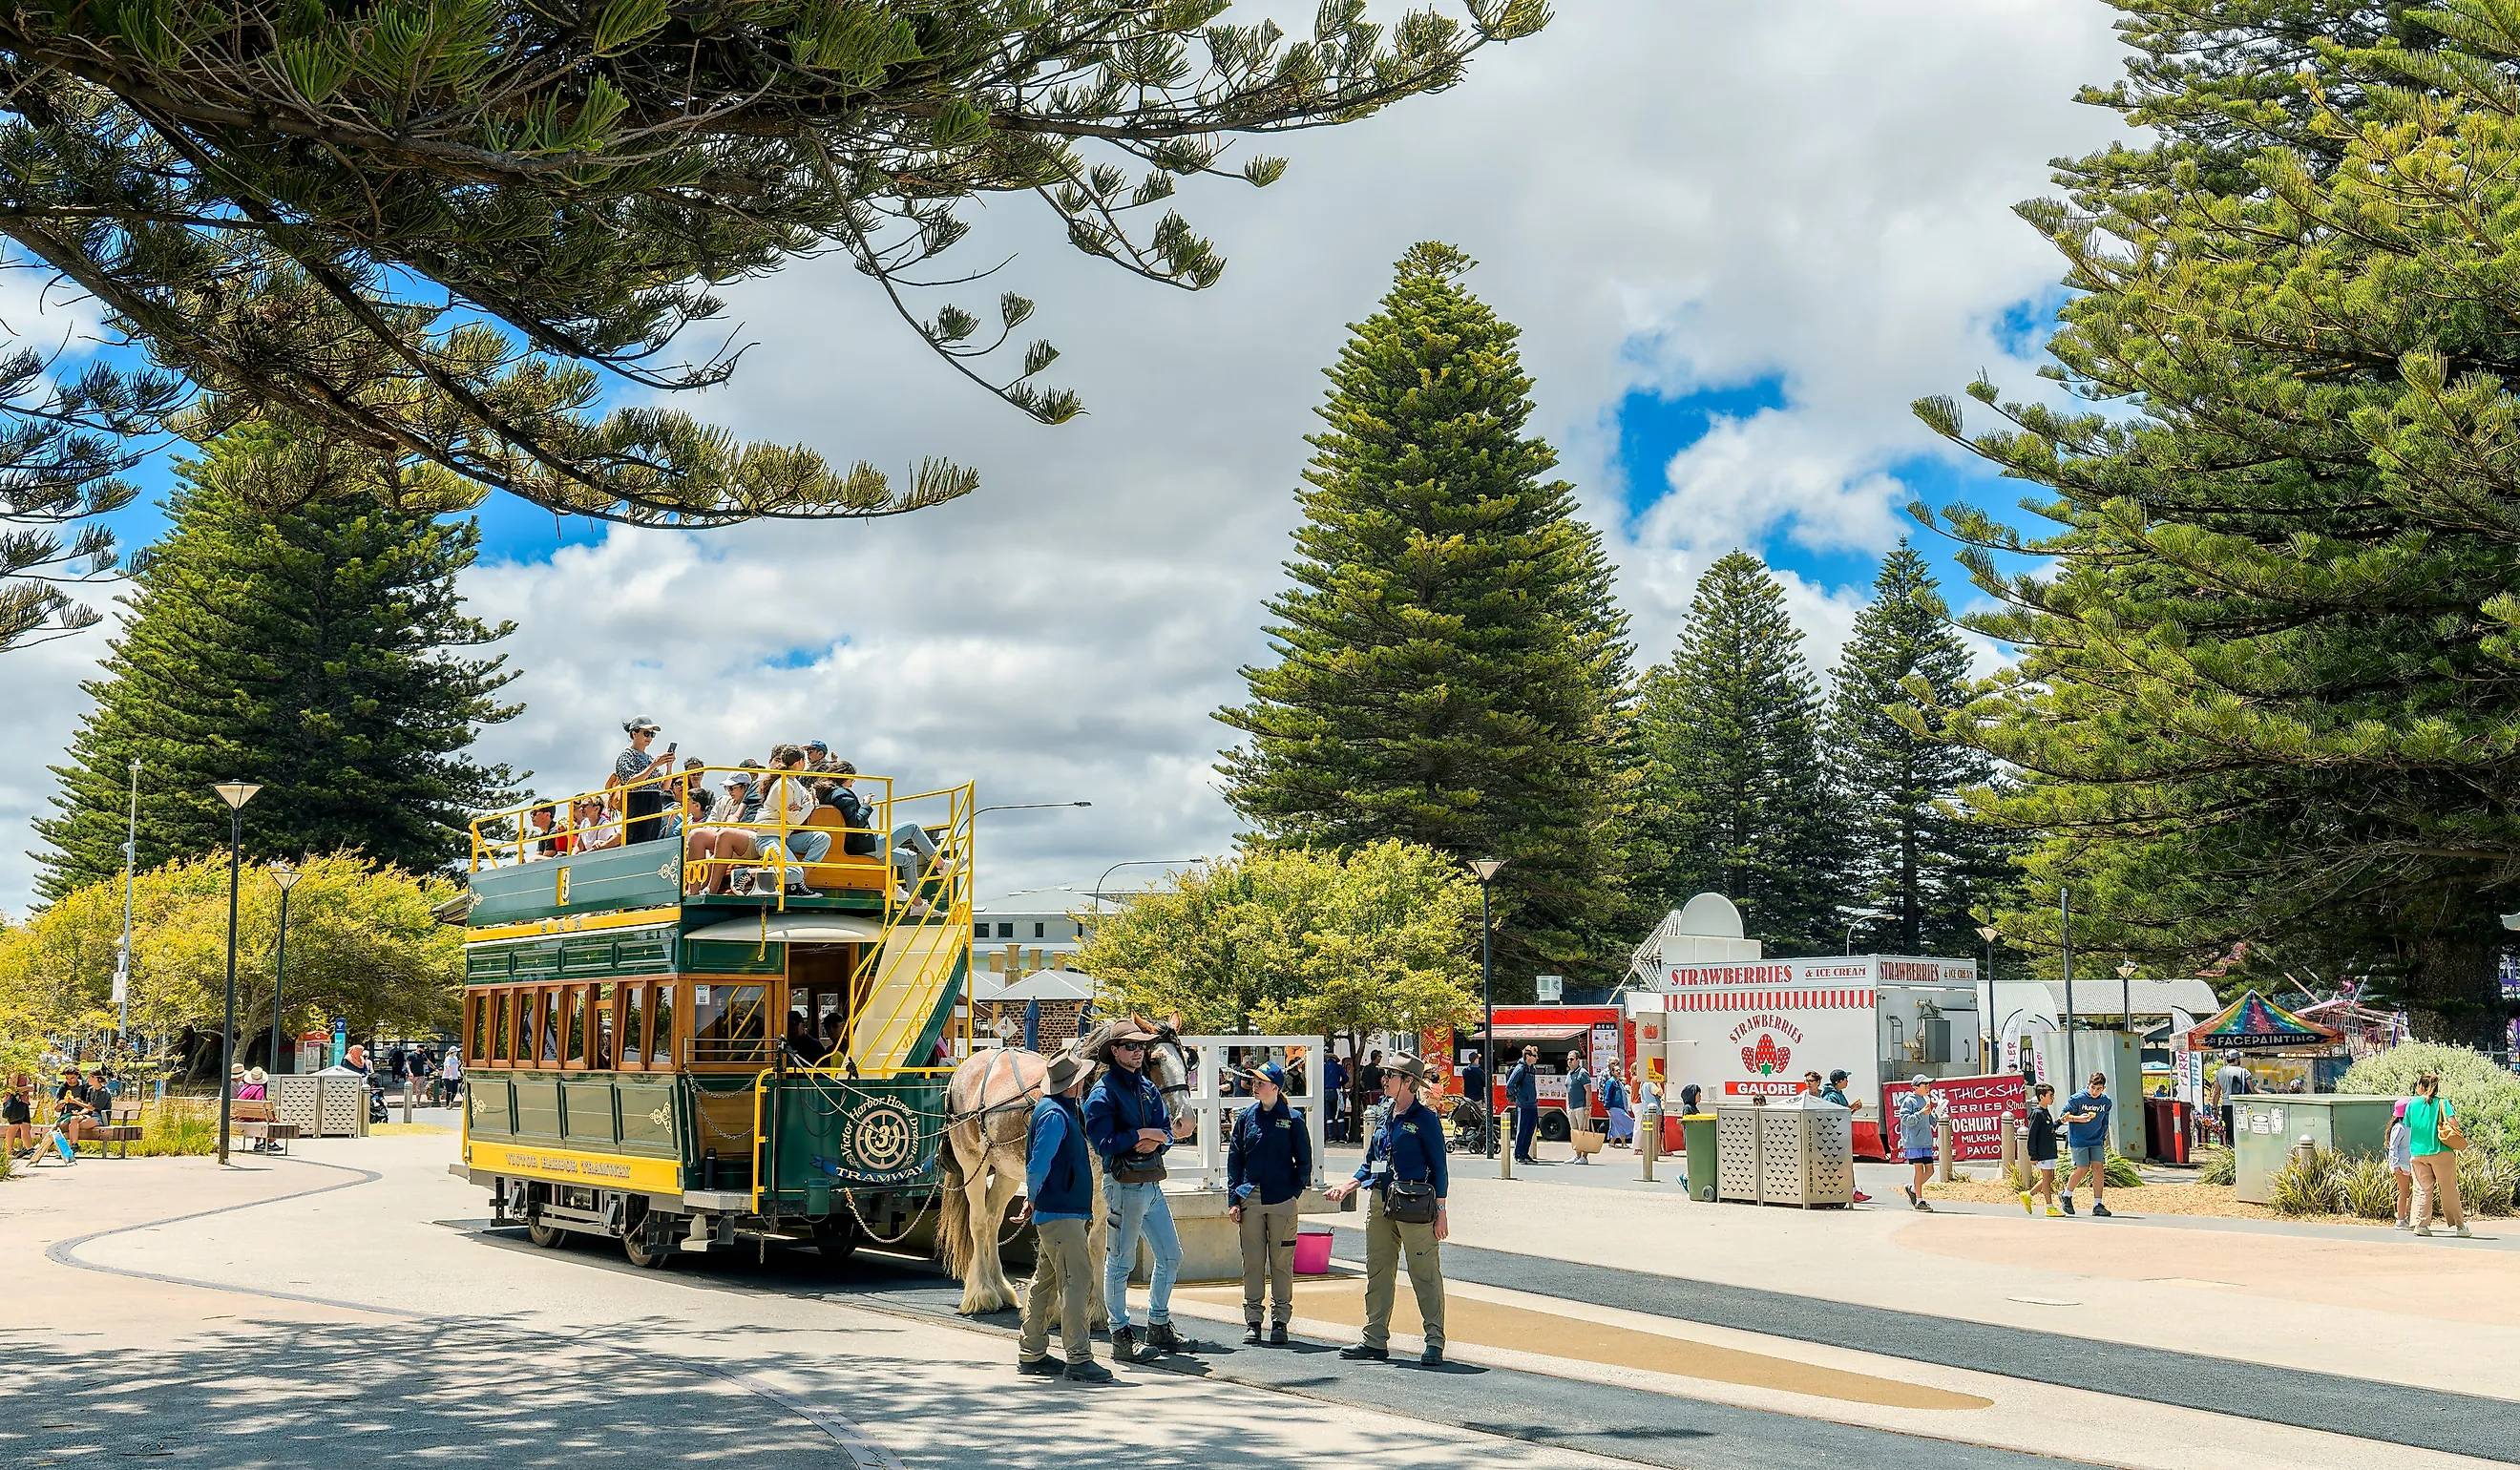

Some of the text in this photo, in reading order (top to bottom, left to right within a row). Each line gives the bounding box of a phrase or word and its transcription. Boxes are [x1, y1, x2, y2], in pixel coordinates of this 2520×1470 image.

[560, 870, 571, 902] 3
[1670, 965, 1866, 986] STRAWBERRIES & ICE CREAM
[1880, 960, 1940, 982] STRAWBERRIES
[1948, 968, 1957, 979] ICE
[1729, 1014, 1804, 1044] STRAWBERRIES
[1737, 1083, 1797, 1095] GALORE
[2081, 1103, 2100, 1112] Hurley
[840, 1094, 919, 1157] Victor Harbor Horse Drawn
[1949, 1116, 2000, 1133] OGHURT
[874, 1124, 891, 1148] 3
[506, 1152, 631, 1179] VICTOR HARBOR TRAMWAY
[835, 1163, 925, 1184] TRAMWAY
